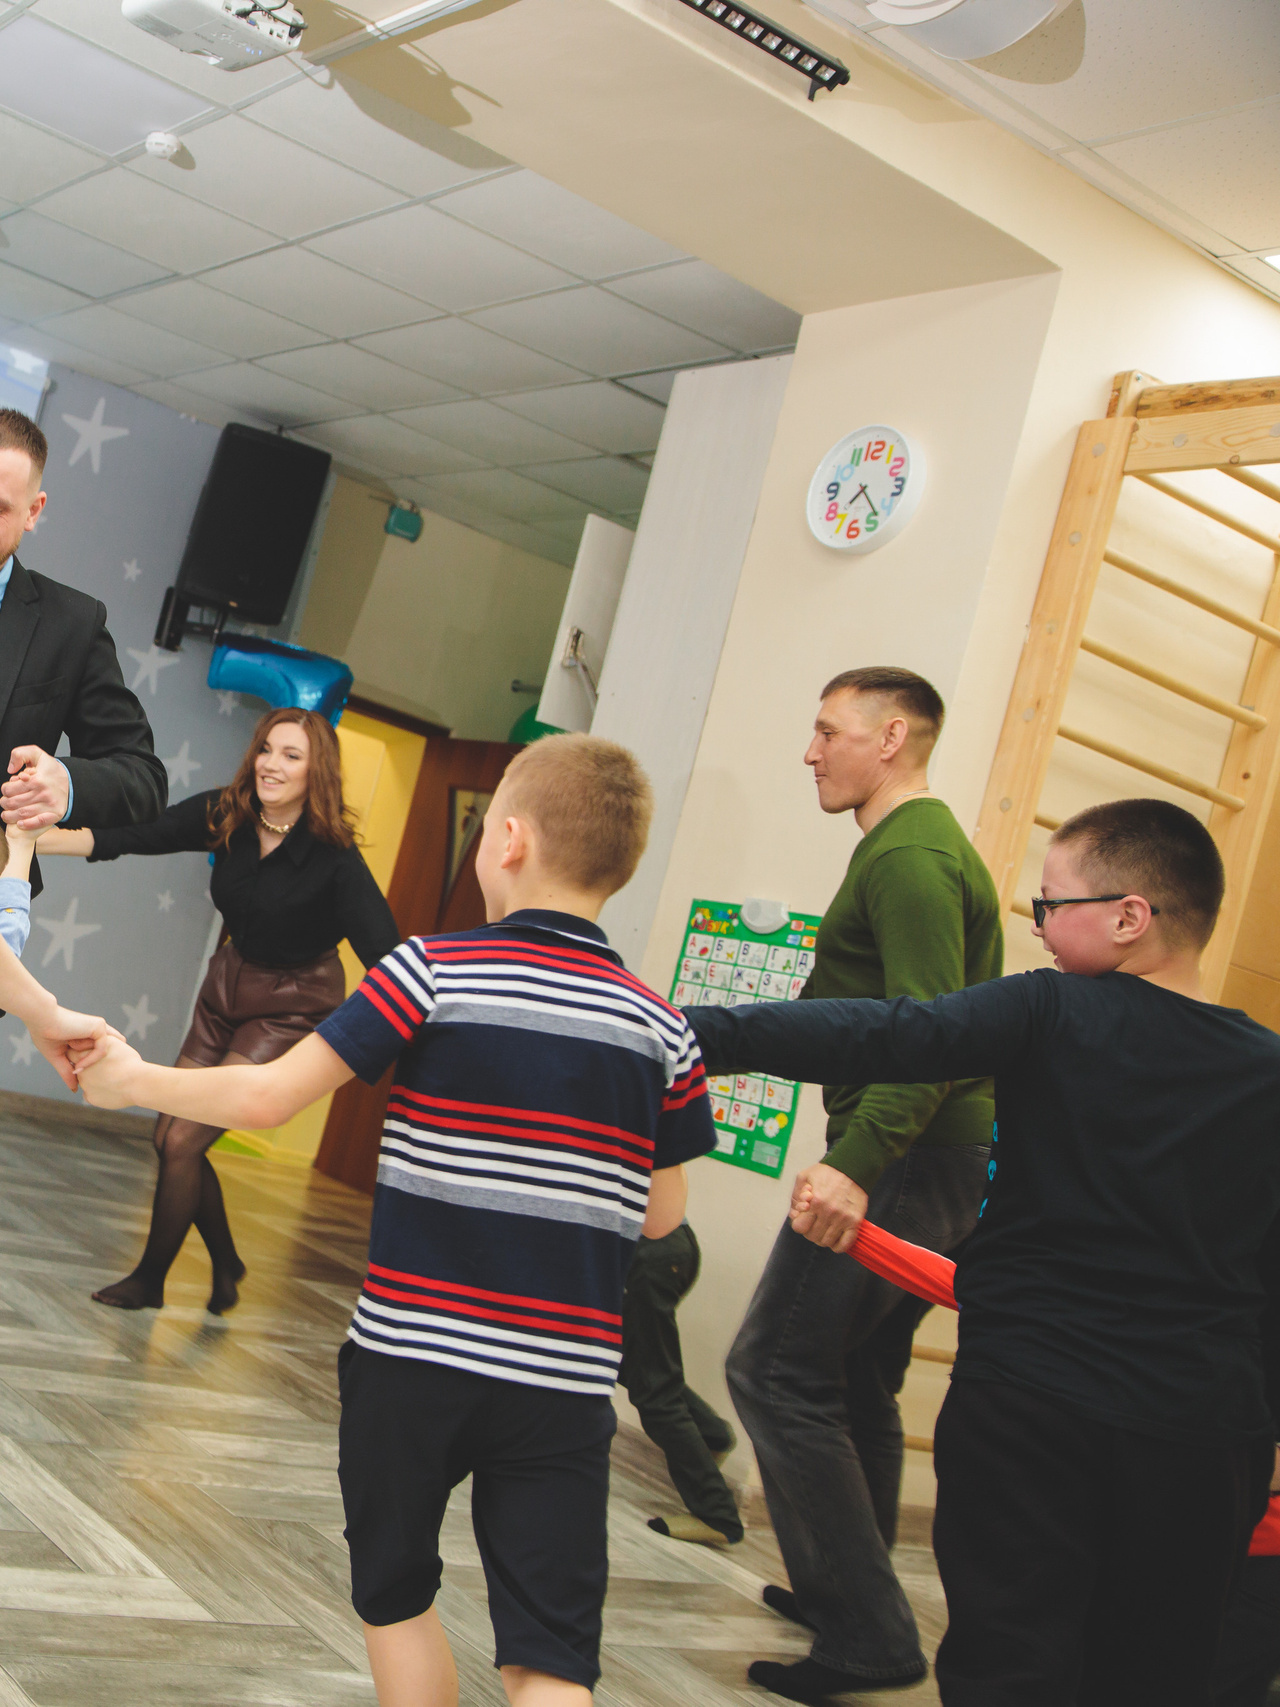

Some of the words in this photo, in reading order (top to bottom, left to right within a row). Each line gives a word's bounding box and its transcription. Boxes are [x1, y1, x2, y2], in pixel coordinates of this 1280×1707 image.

[850, 447, 863, 467] 11
[864, 440, 886, 462] 12
[885, 444, 895, 464] 1
[833, 463, 855, 483] 10
[889, 457, 905, 477] 2
[826, 482, 839, 501] 9
[890, 477, 906, 497] 3
[825, 502, 839, 521] 8
[881, 497, 894, 516] 4
[835, 513, 848, 534] 7
[846, 519, 860, 539] 6
[865, 511, 879, 532] 5
[716, 939, 724, 951] Б
[742, 943, 750, 955] В
[771, 948, 779, 960] Г
[799, 953, 808, 968] Д
[733, 968, 744, 981] Ж
[733, 1103, 741, 1116] Я
